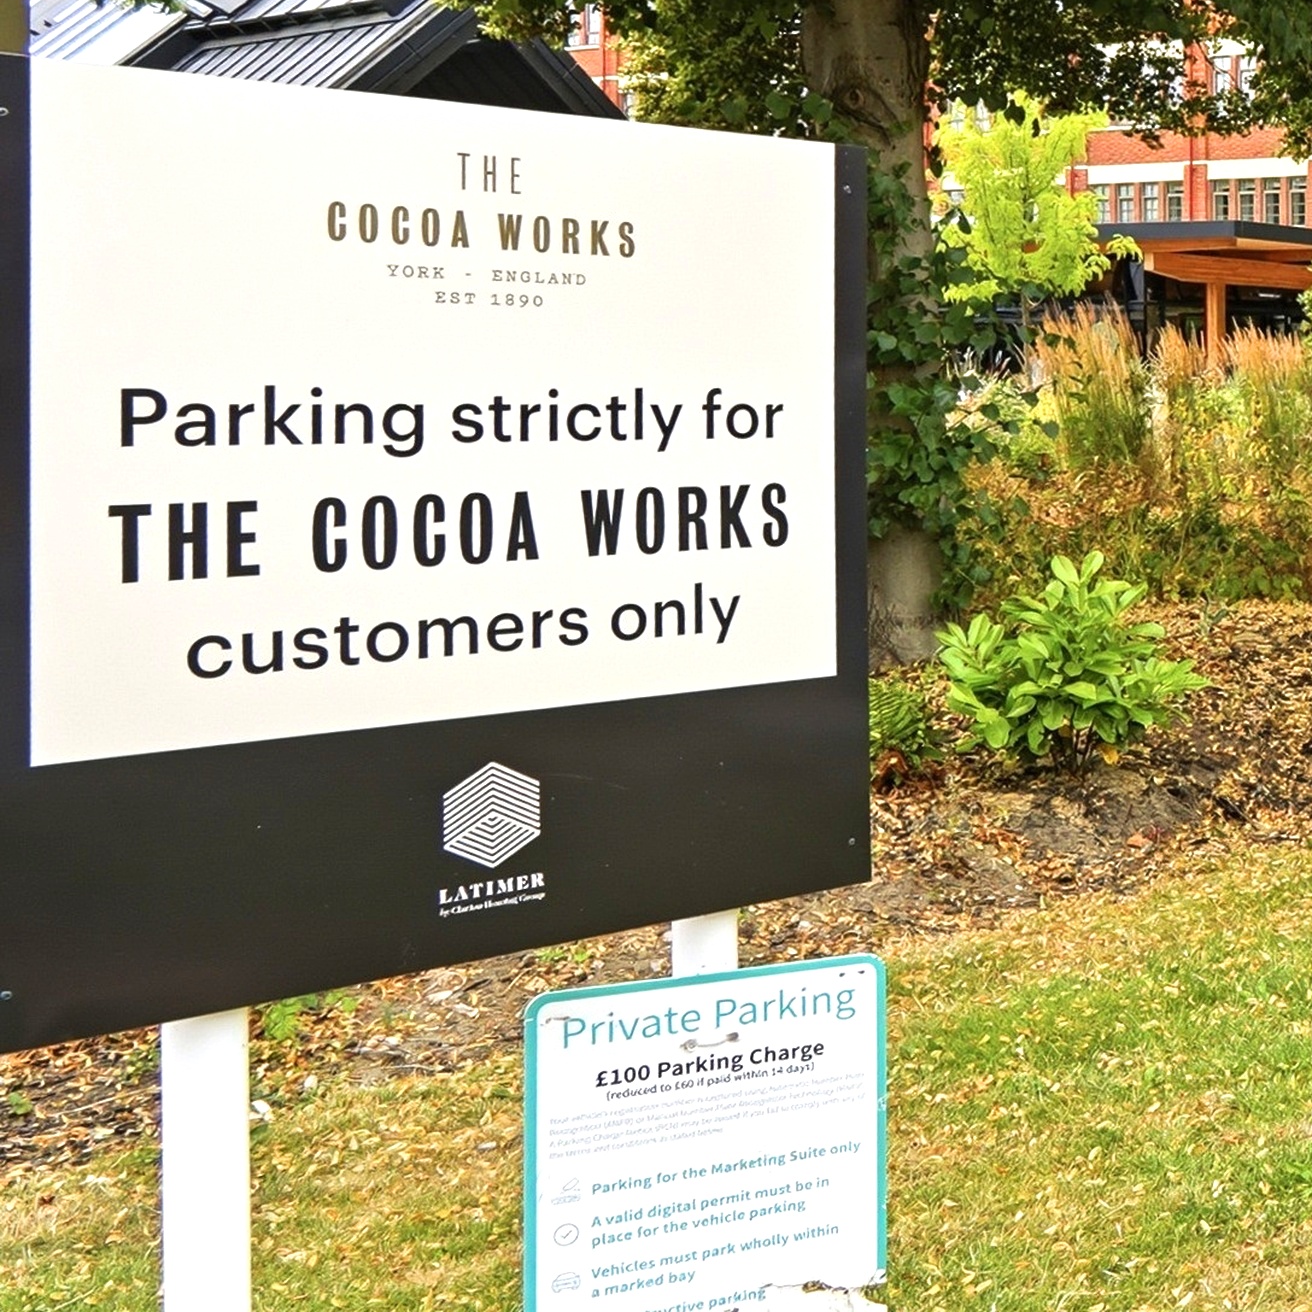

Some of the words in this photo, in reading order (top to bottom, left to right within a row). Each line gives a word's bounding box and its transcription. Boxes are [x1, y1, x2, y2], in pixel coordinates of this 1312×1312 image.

[456, 151, 522, 196] THE
[326, 200, 470, 249] COCOA
[497, 212, 637, 259] WORKS
[387, 263, 446, 280] YORK
[491, 269, 587, 287] ENGLAND
[434, 290, 477, 306] EST
[490, 293, 544, 309] 1890
[120, 385, 426, 458] Parking
[451, 387, 684, 453] strictly
[701, 388, 784, 440] for
[107, 500, 261, 584] THE
[311, 490, 540, 574] COCOA
[580, 482, 790, 558] WORKS
[186, 607, 589, 680] customers
[610, 583, 742, 645] only
[439, 872, 546, 905] LATIMER
[562, 1005, 701, 1050] Private
[714, 986, 857, 1029] Parking
[595, 1064, 651, 1088] £100
[658, 1053, 744, 1079] Parking
[749, 1042, 825, 1065] Charge
[606, 1084, 658, 1102] (reduced
[660, 1083, 672, 1093] to
[697, 1077, 705, 1087] if
[707, 1074, 731, 1088] paid
[734, 1068, 769, 1082] within
[591, 1175, 653, 1196] Parking
[656, 1171, 678, 1185] for
[682, 1167, 707, 1180] the
[711, 1152, 786, 1175] Marketing
[789, 1147, 827, 1162] Suite
[830, 1141, 861, 1155] only
[591, 1216, 602, 1228] A
[605, 1208, 644, 1226] valid
[647, 1199, 697, 1219] digital
[700, 1190, 751, 1211] permit
[755, 1184, 792, 1199] must
[795, 1180, 813, 1193] be
[816, 1177, 830, 1189] in
[591, 1231, 633, 1250] place
[637, 1225, 659, 1239] for
[663, 1220, 688, 1234] the
[692, 1210, 746, 1229] vehicle
[749, 1199, 806, 1221] parking
[591, 1259, 656, 1279] Vehicles
[660, 1250, 698, 1267] must
[702, 1243, 737, 1262] park
[740, 1233, 790, 1253] wholly
[793, 1224, 839, 1242] within
[591, 1289, 600, 1298] a
[604, 1274, 665, 1296] marked
[668, 1270, 696, 1284] bay
[708, 1289, 766, 1310] parking
